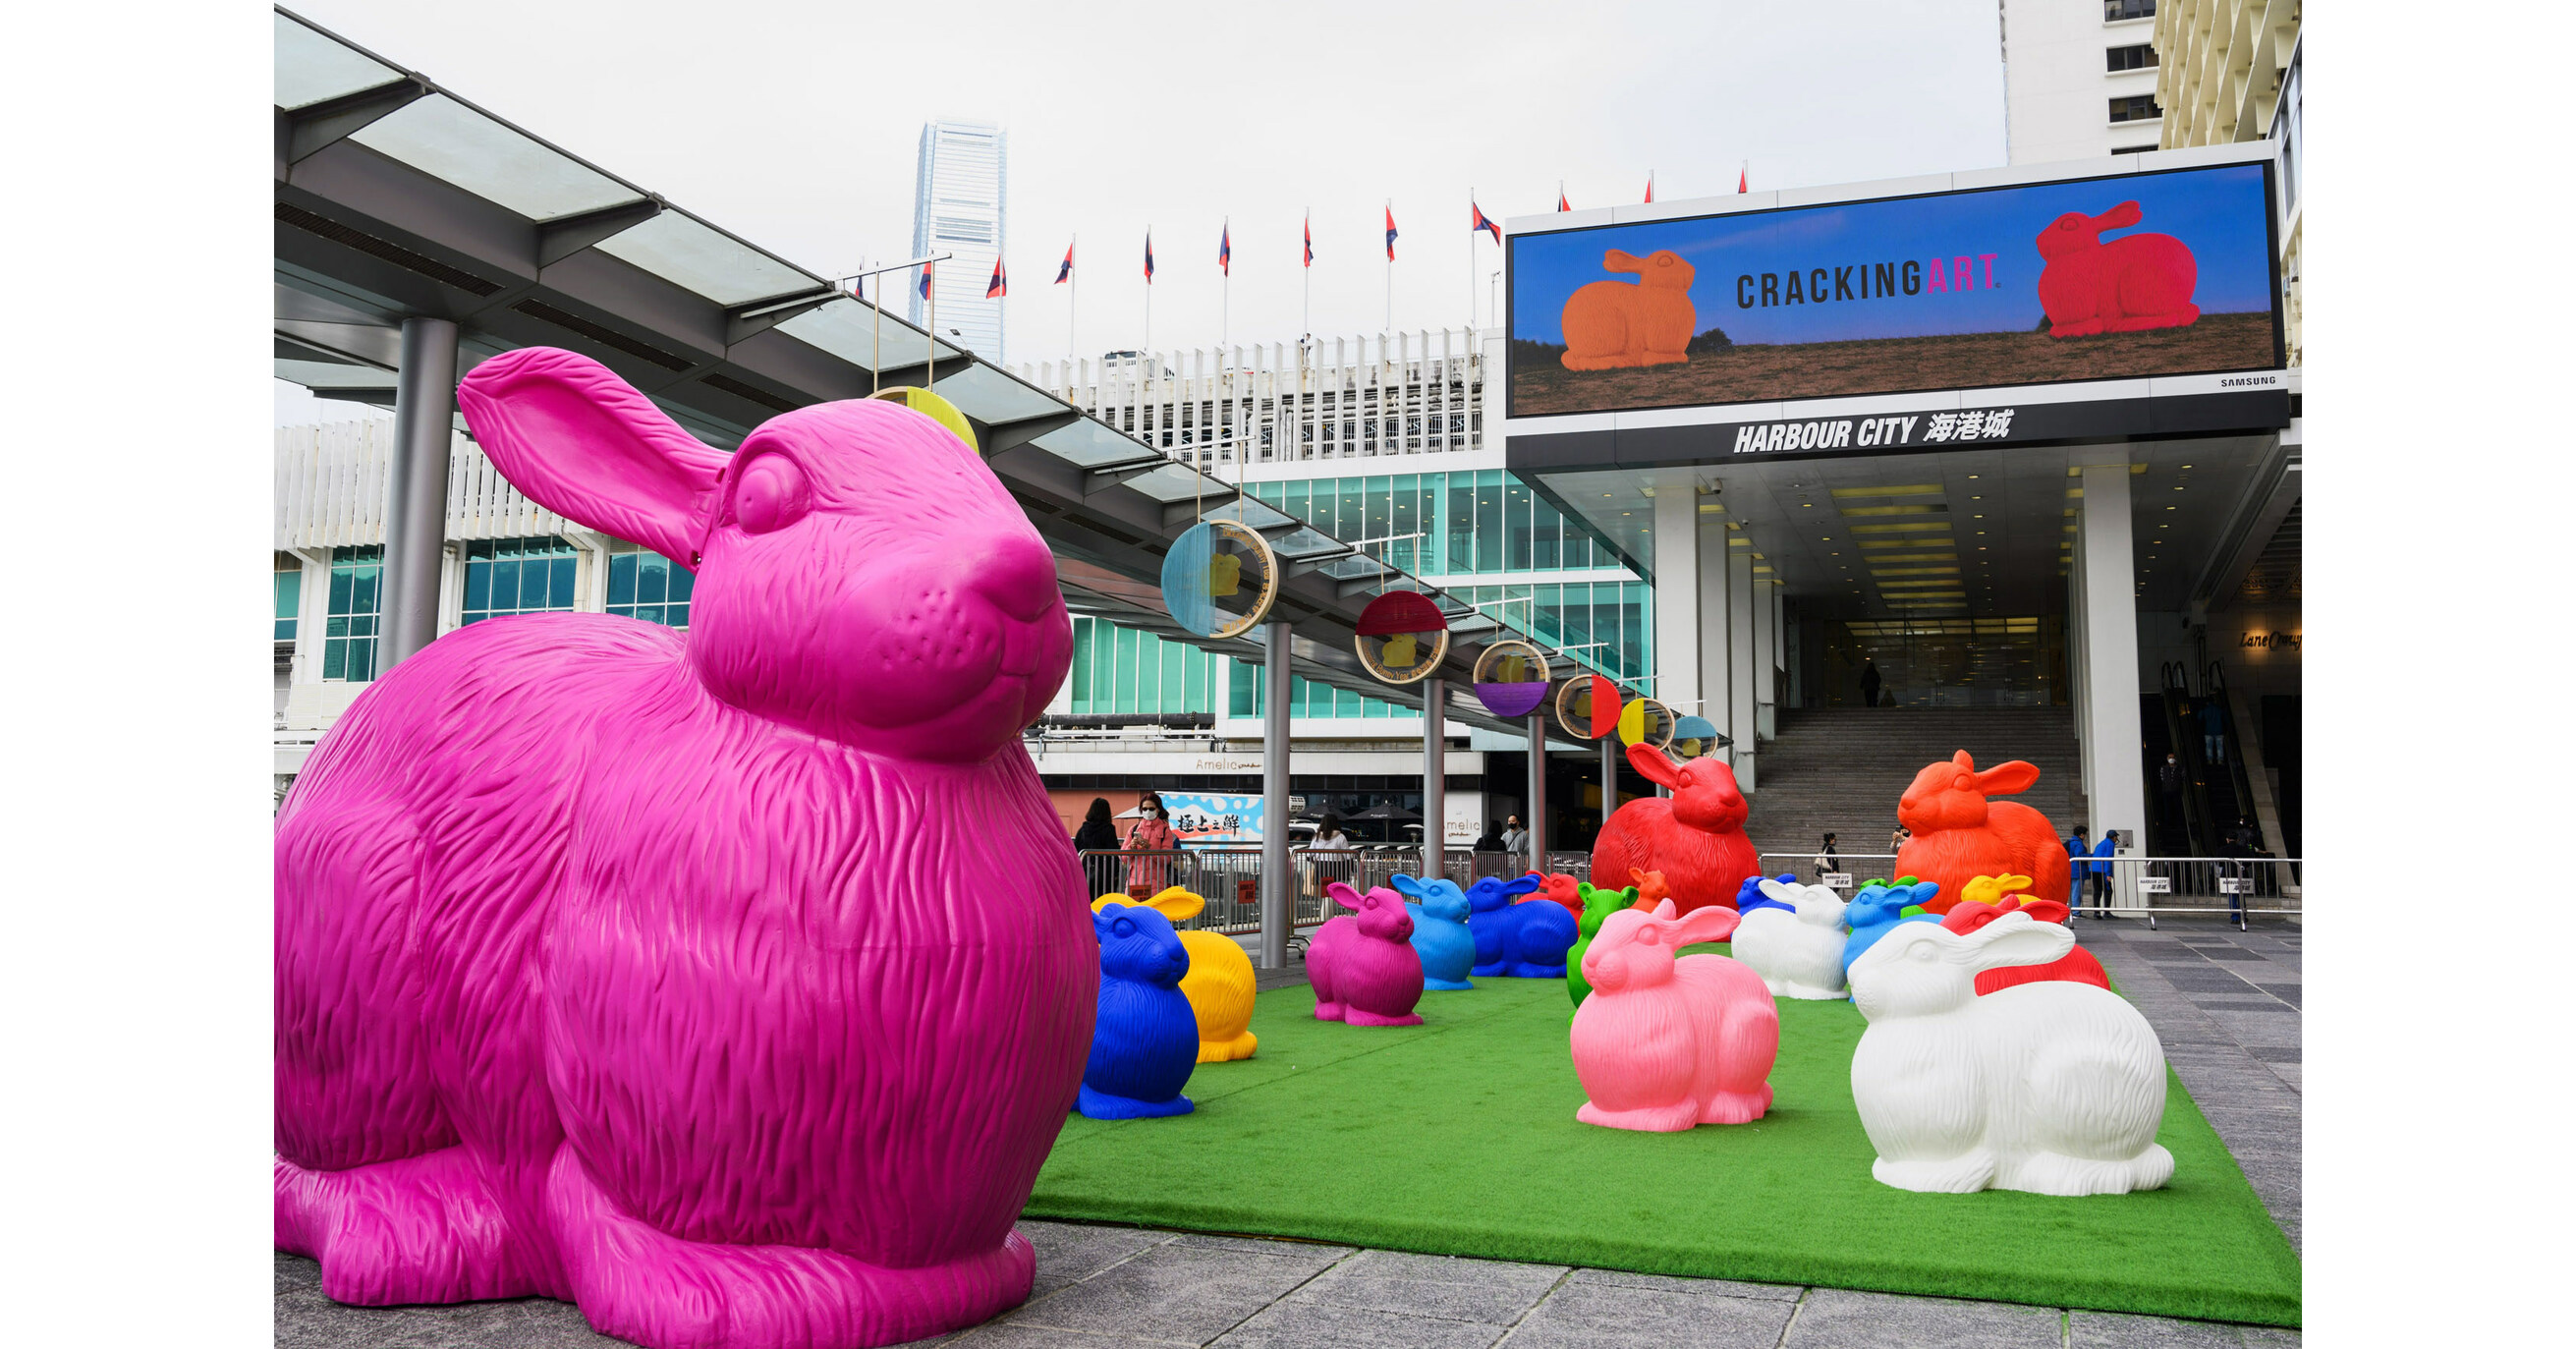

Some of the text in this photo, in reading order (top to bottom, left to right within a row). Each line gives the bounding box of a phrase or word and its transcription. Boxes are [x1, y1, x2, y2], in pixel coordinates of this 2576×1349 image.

[2220, 376, 2276, 387] SAMSUNG
[1733, 409, 2015, 453] HARBOUR CITY 海港城
[2239, 632, 2268, 647] Lane
[1177, 814, 1240, 837] 極上之鮮
